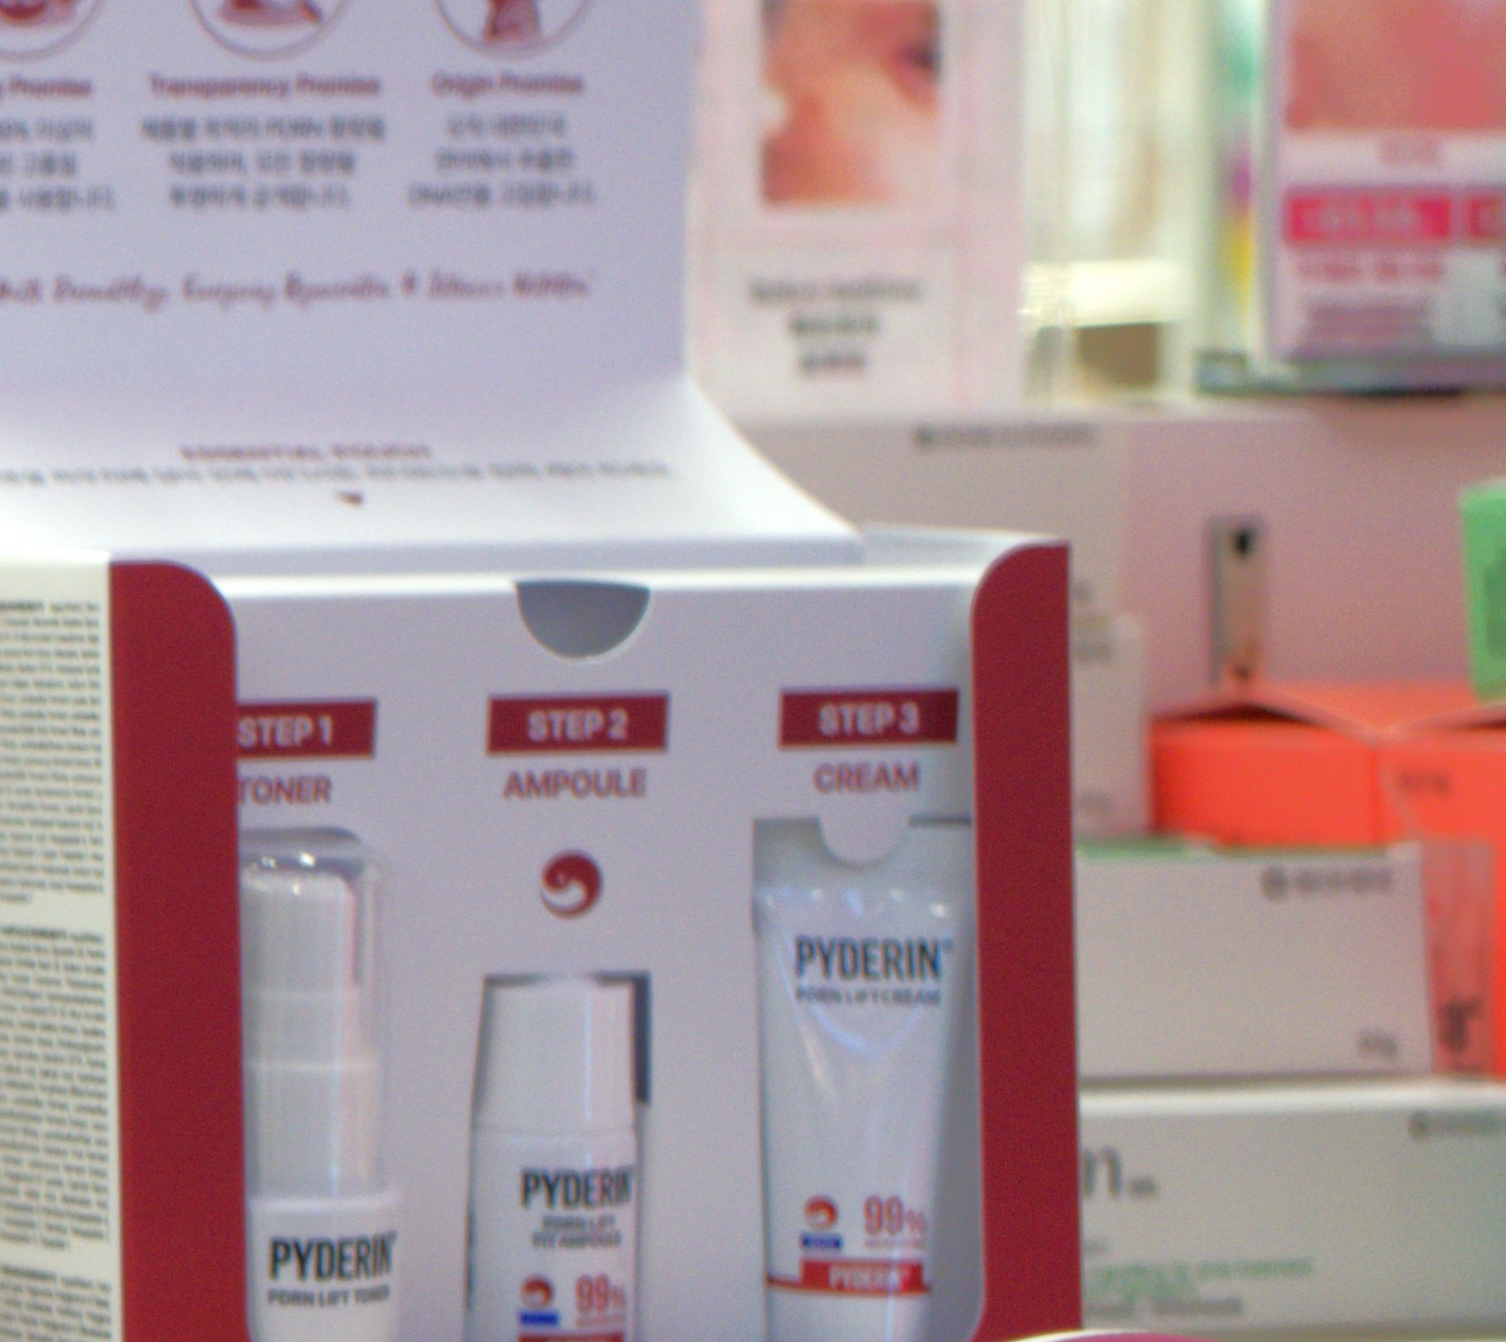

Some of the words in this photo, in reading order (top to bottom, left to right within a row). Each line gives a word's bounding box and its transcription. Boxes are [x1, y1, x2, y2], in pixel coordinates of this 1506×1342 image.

[237, 712, 315, 749] STEP
[319, 711, 334, 747] 1
[527, 710, 603, 743] STEP
[606, 709, 630, 741] 2
[818, 704, 892, 737] STEP
[897, 703, 921, 735] 3
[237, 775, 333, 806] TONER
[502, 768, 648, 800] AMPOULE
[812, 763, 921, 794] CREAM
[794, 934, 943, 982] PYDERIN
[862, 1194, 929, 1237] 99%
[268, 1233, 393, 1281] PYDERIN
